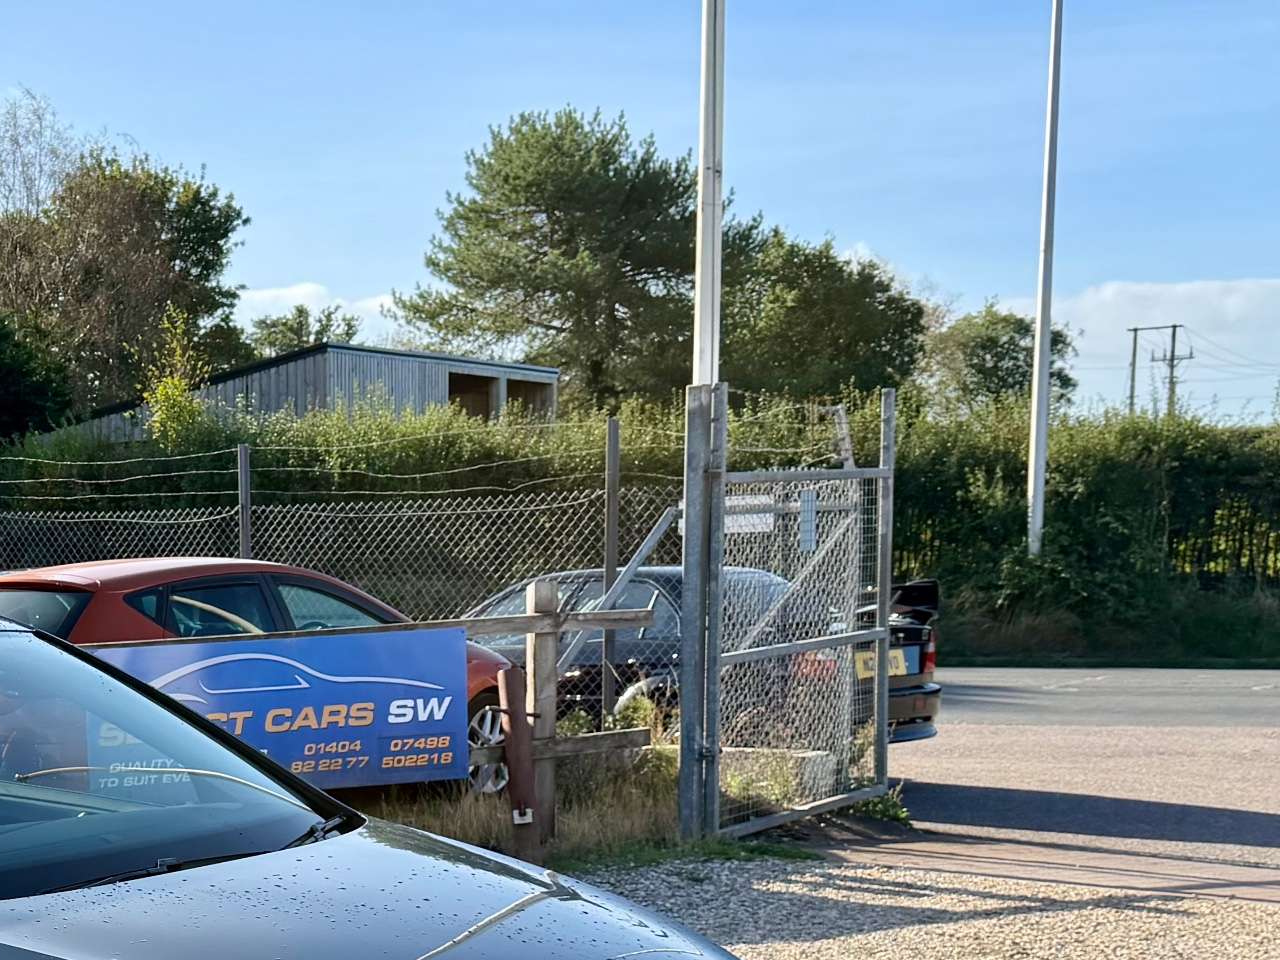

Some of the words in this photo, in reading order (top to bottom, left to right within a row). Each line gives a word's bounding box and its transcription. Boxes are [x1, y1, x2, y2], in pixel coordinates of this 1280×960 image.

[264, 702, 375, 733] CARS
[387, 695, 453, 724] SW
[303, 739, 362, 756] 01404
[390, 736, 451, 752] 07498
[381, 752, 453, 769] 502218
[99, 778, 119, 788] TO
